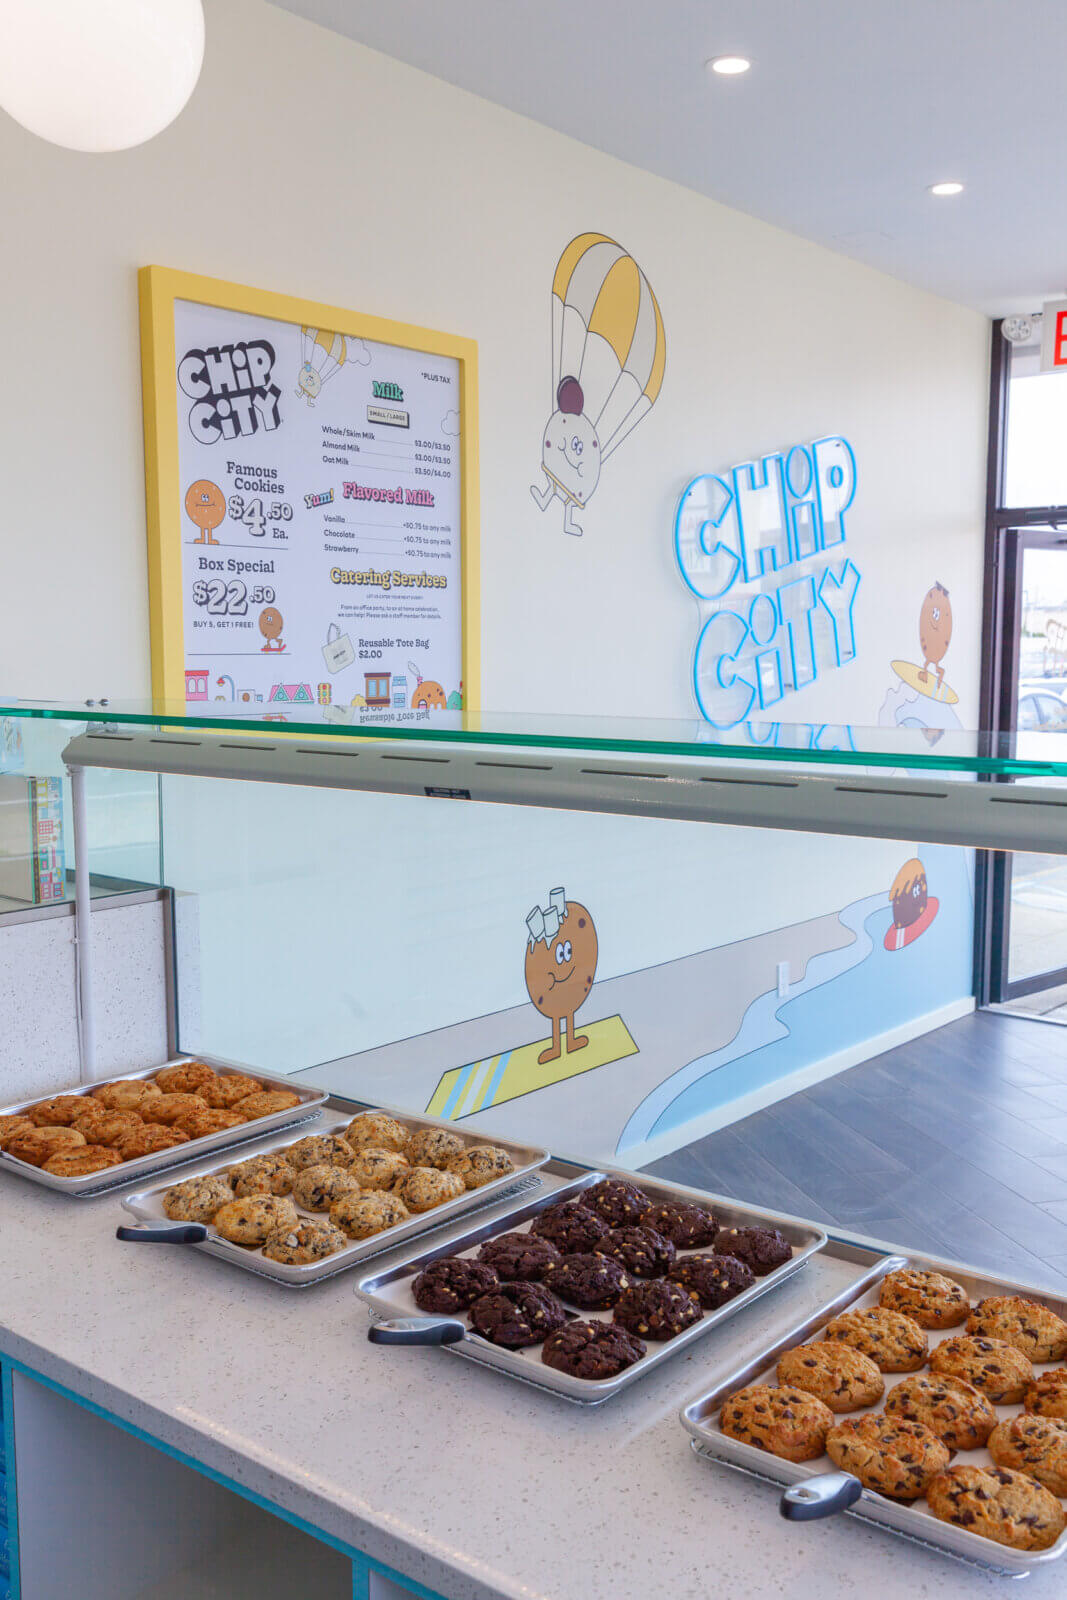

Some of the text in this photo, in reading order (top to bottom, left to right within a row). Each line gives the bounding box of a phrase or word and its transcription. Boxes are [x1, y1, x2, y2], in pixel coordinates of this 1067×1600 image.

[440, 375, 451, 384] TAX
[372, 380, 404, 402] Milk
[362, 431, 375, 441] Milk
[322, 441, 346, 451] Almond
[347, 443, 360, 452] Milk
[322, 455, 335, 464] Oat
[336, 457, 349, 465] Milk
[226, 461, 278, 479] Famous
[234, 477, 285, 494] Cookies
[304, 488, 334, 509] Yum!
[342, 481, 435, 507] Flavored Milk
[323, 514, 346, 523] Vanilla
[429, 525, 439, 533] any
[272, 528, 289, 539] Ea.
[323, 529, 355, 539] Chocolate
[429, 539, 439, 547] any
[324, 544, 359, 554] Strawberry
[429, 552, 440, 560] any
[198, 557, 275, 574] Box Special
[330, 566, 447, 590] Catering Services
[193, 620, 207, 628] BUY
[358, 638, 430, 649] Reusable Tote Bag
[358, 650, 382, 659] $2.00
